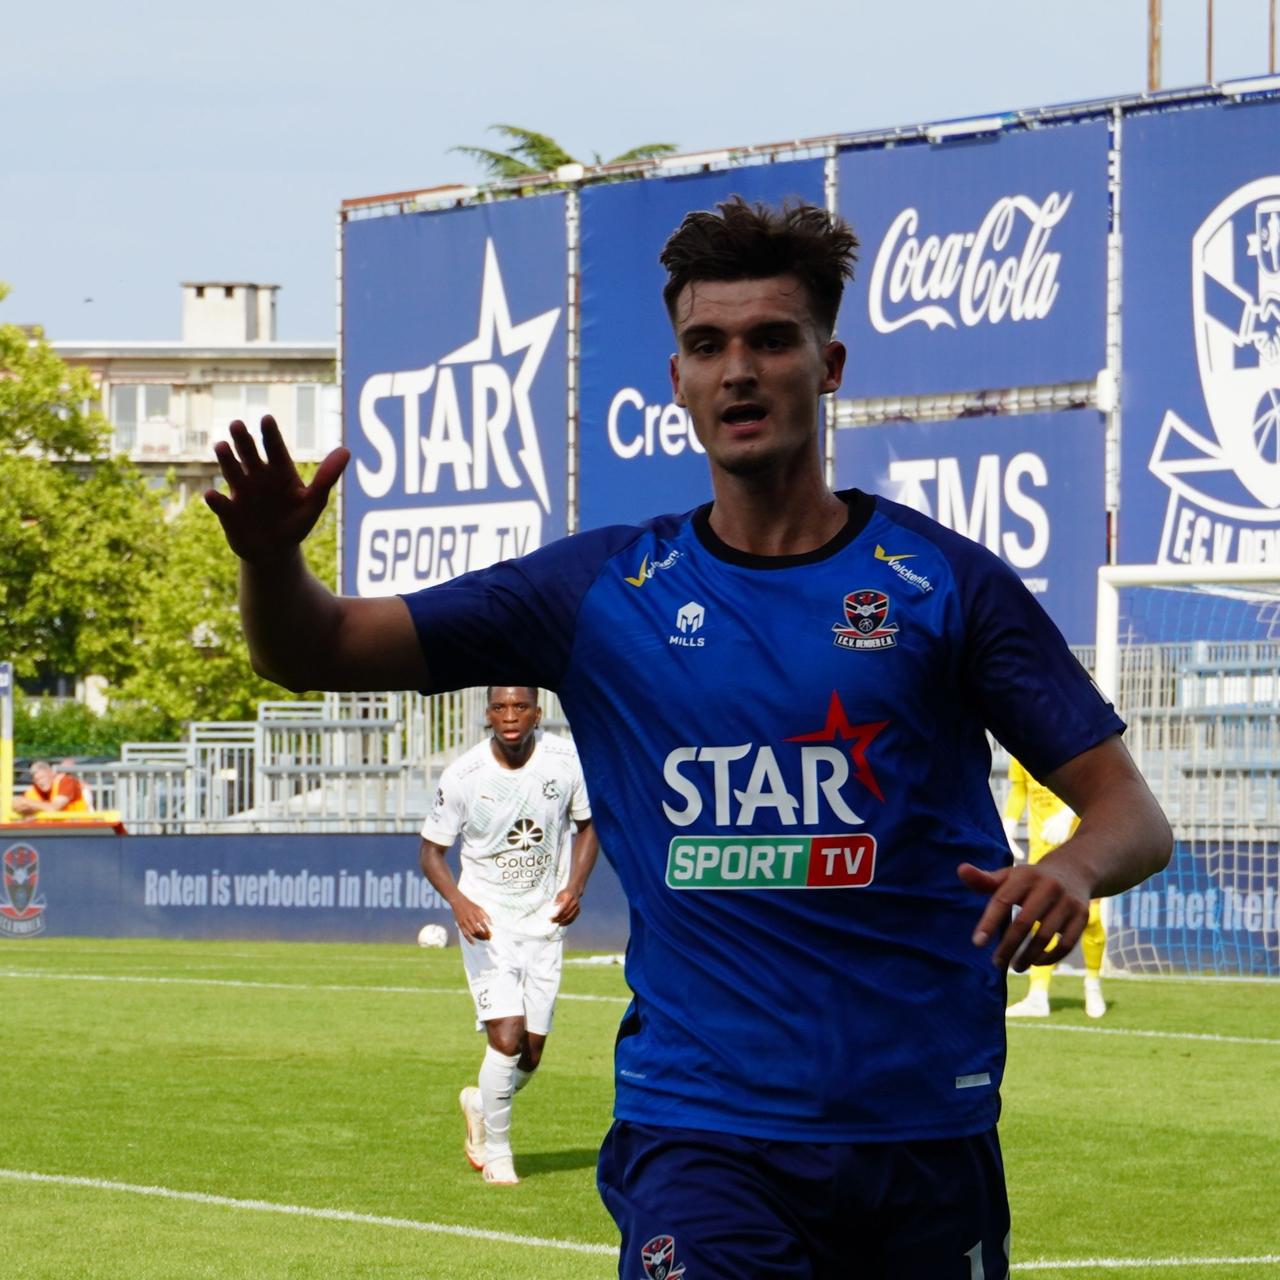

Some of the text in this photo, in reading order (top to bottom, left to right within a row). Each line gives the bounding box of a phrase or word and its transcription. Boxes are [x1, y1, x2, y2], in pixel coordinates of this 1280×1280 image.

[869, 190, 1074, 334] Coca-Cola
[356, 363, 521, 498] STAR
[889, 453, 1050, 568] TMS
[368, 524, 531, 582] SPORT TV
[1173, 507, 1233, 564] F.C.V
[888, 559, 934, 592] Valckenier
[669, 635, 705, 647] MILLS
[856, 640, 881, 649] DENDER
[662, 742, 865, 827] STAR
[495, 854, 552, 868] Golden
[673, 844, 867, 881] SPORT TV
[144, 870, 207, 907] Roken
[211, 869, 231, 906] is
[234, 869, 334, 908] verboden
[339, 870, 361, 908] in
[365, 870, 402, 909] het
[1129, 886, 1159, 929] in
[1166, 885, 1220, 930] het
